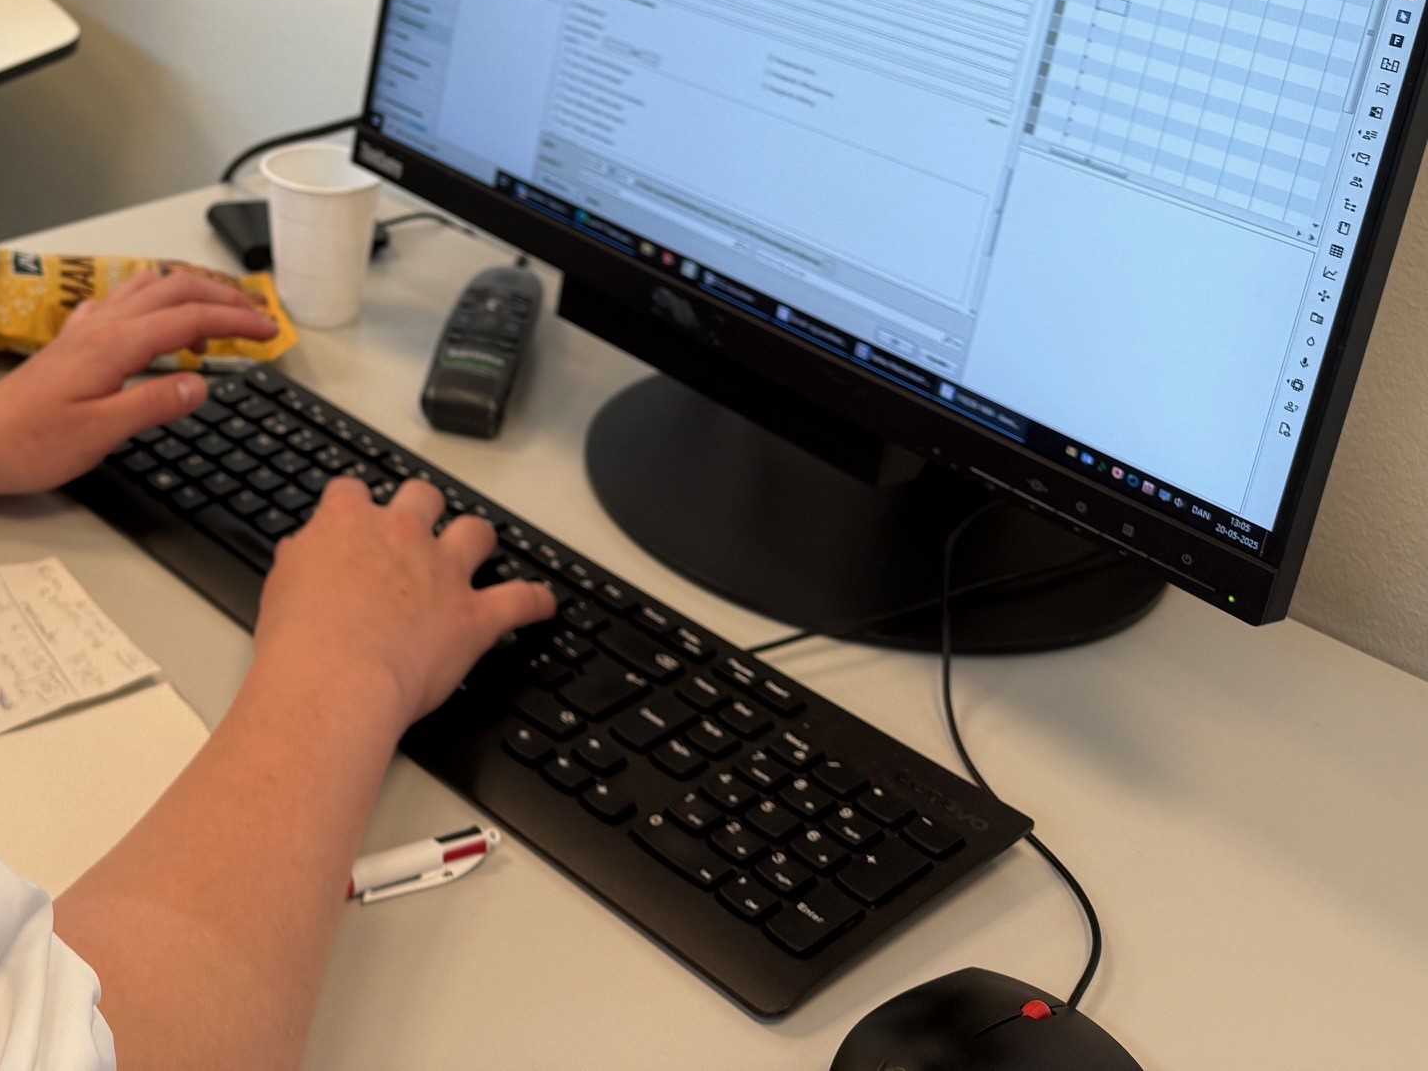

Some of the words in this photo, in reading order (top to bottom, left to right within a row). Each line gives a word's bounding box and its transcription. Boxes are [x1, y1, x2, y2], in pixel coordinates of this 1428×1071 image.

[1191, 504, 1212, 521] DAN
[1230, 516, 1252, 533] 13:05
[1215, 522, 1260, 551] 20-05-2025
[796, 901, 825, 924] Enter
